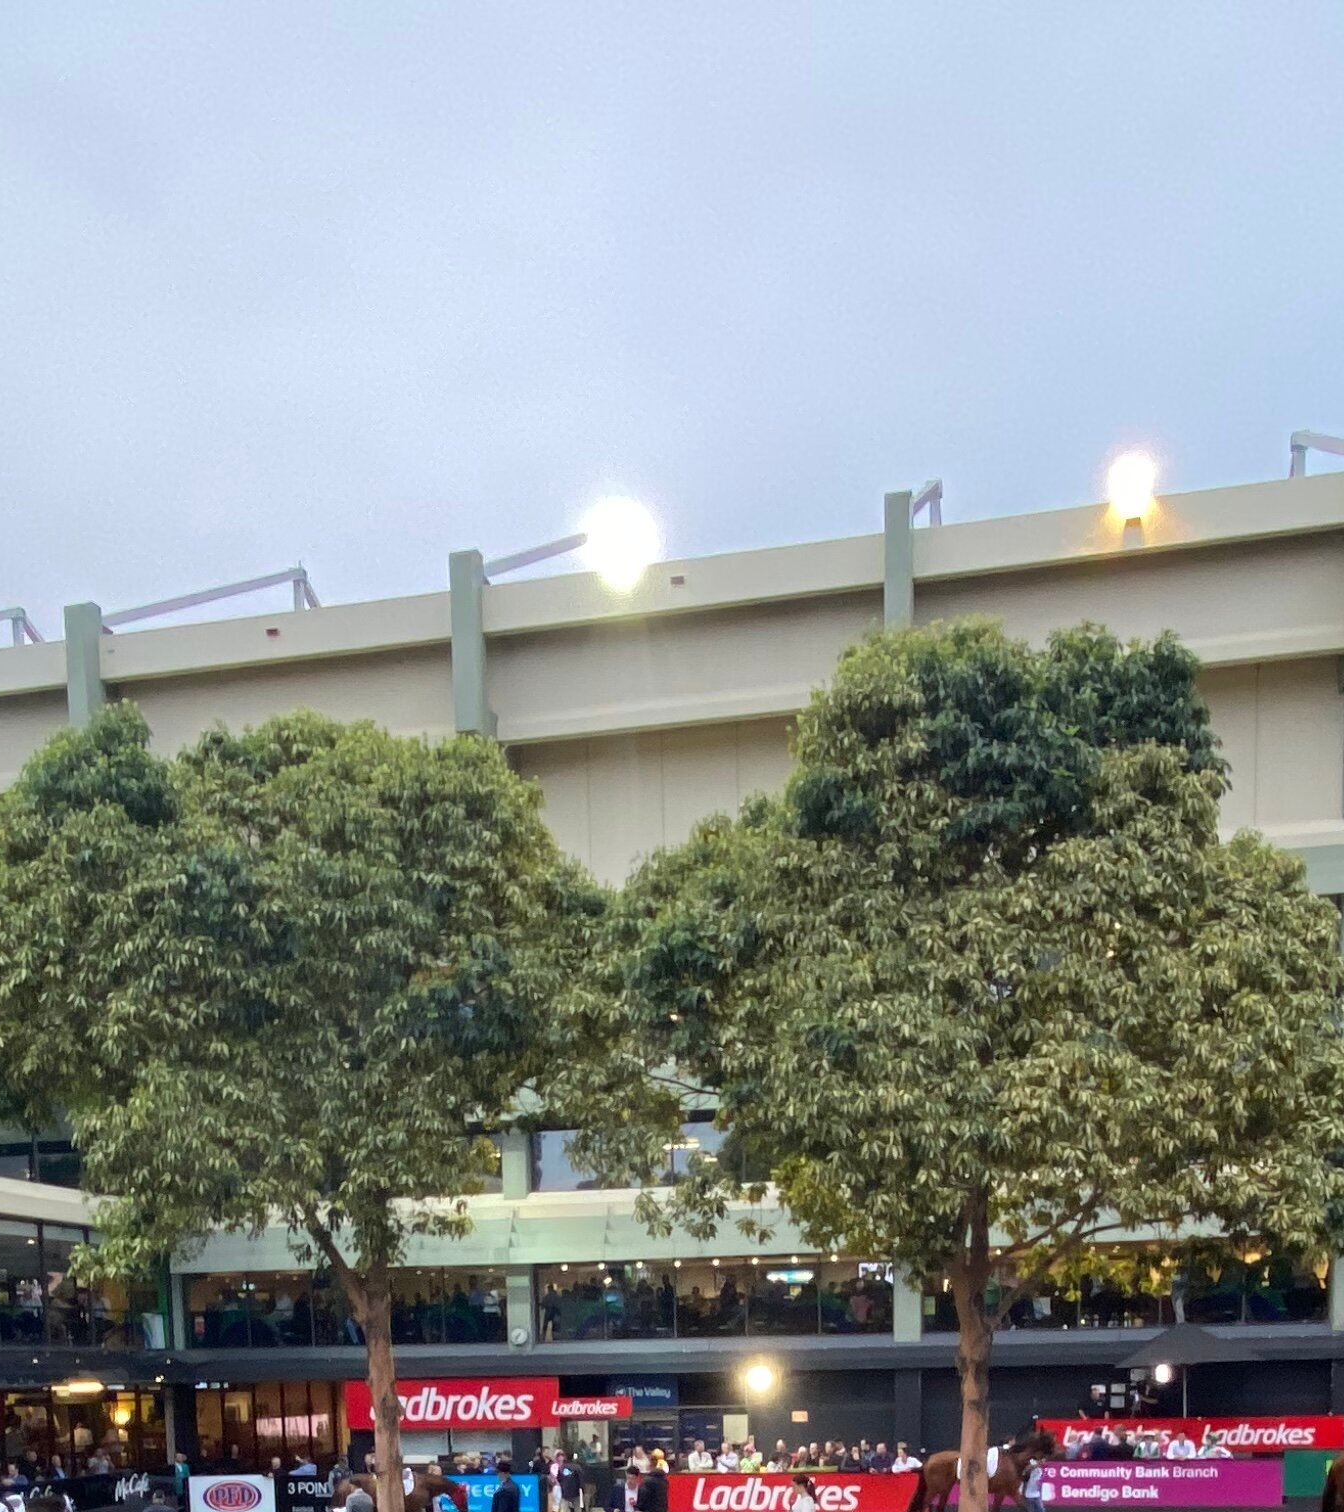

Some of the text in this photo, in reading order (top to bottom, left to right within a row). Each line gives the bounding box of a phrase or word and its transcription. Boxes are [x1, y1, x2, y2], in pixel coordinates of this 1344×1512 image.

[369, 1386, 534, 1422] dbrokes
[551, 1399, 618, 1416] Ladbrokes
[1201, 1424, 1315, 1446] Ladbrokes
[1060, 1466, 1132, 1480] Community
[1135, 1466, 1169, 1478] Bank
[1172, 1466, 1218, 1479] Branch
[288, 1481, 328, 1495] 3 POIN
[1061, 1485, 1159, 1501] Bendigo Bank
